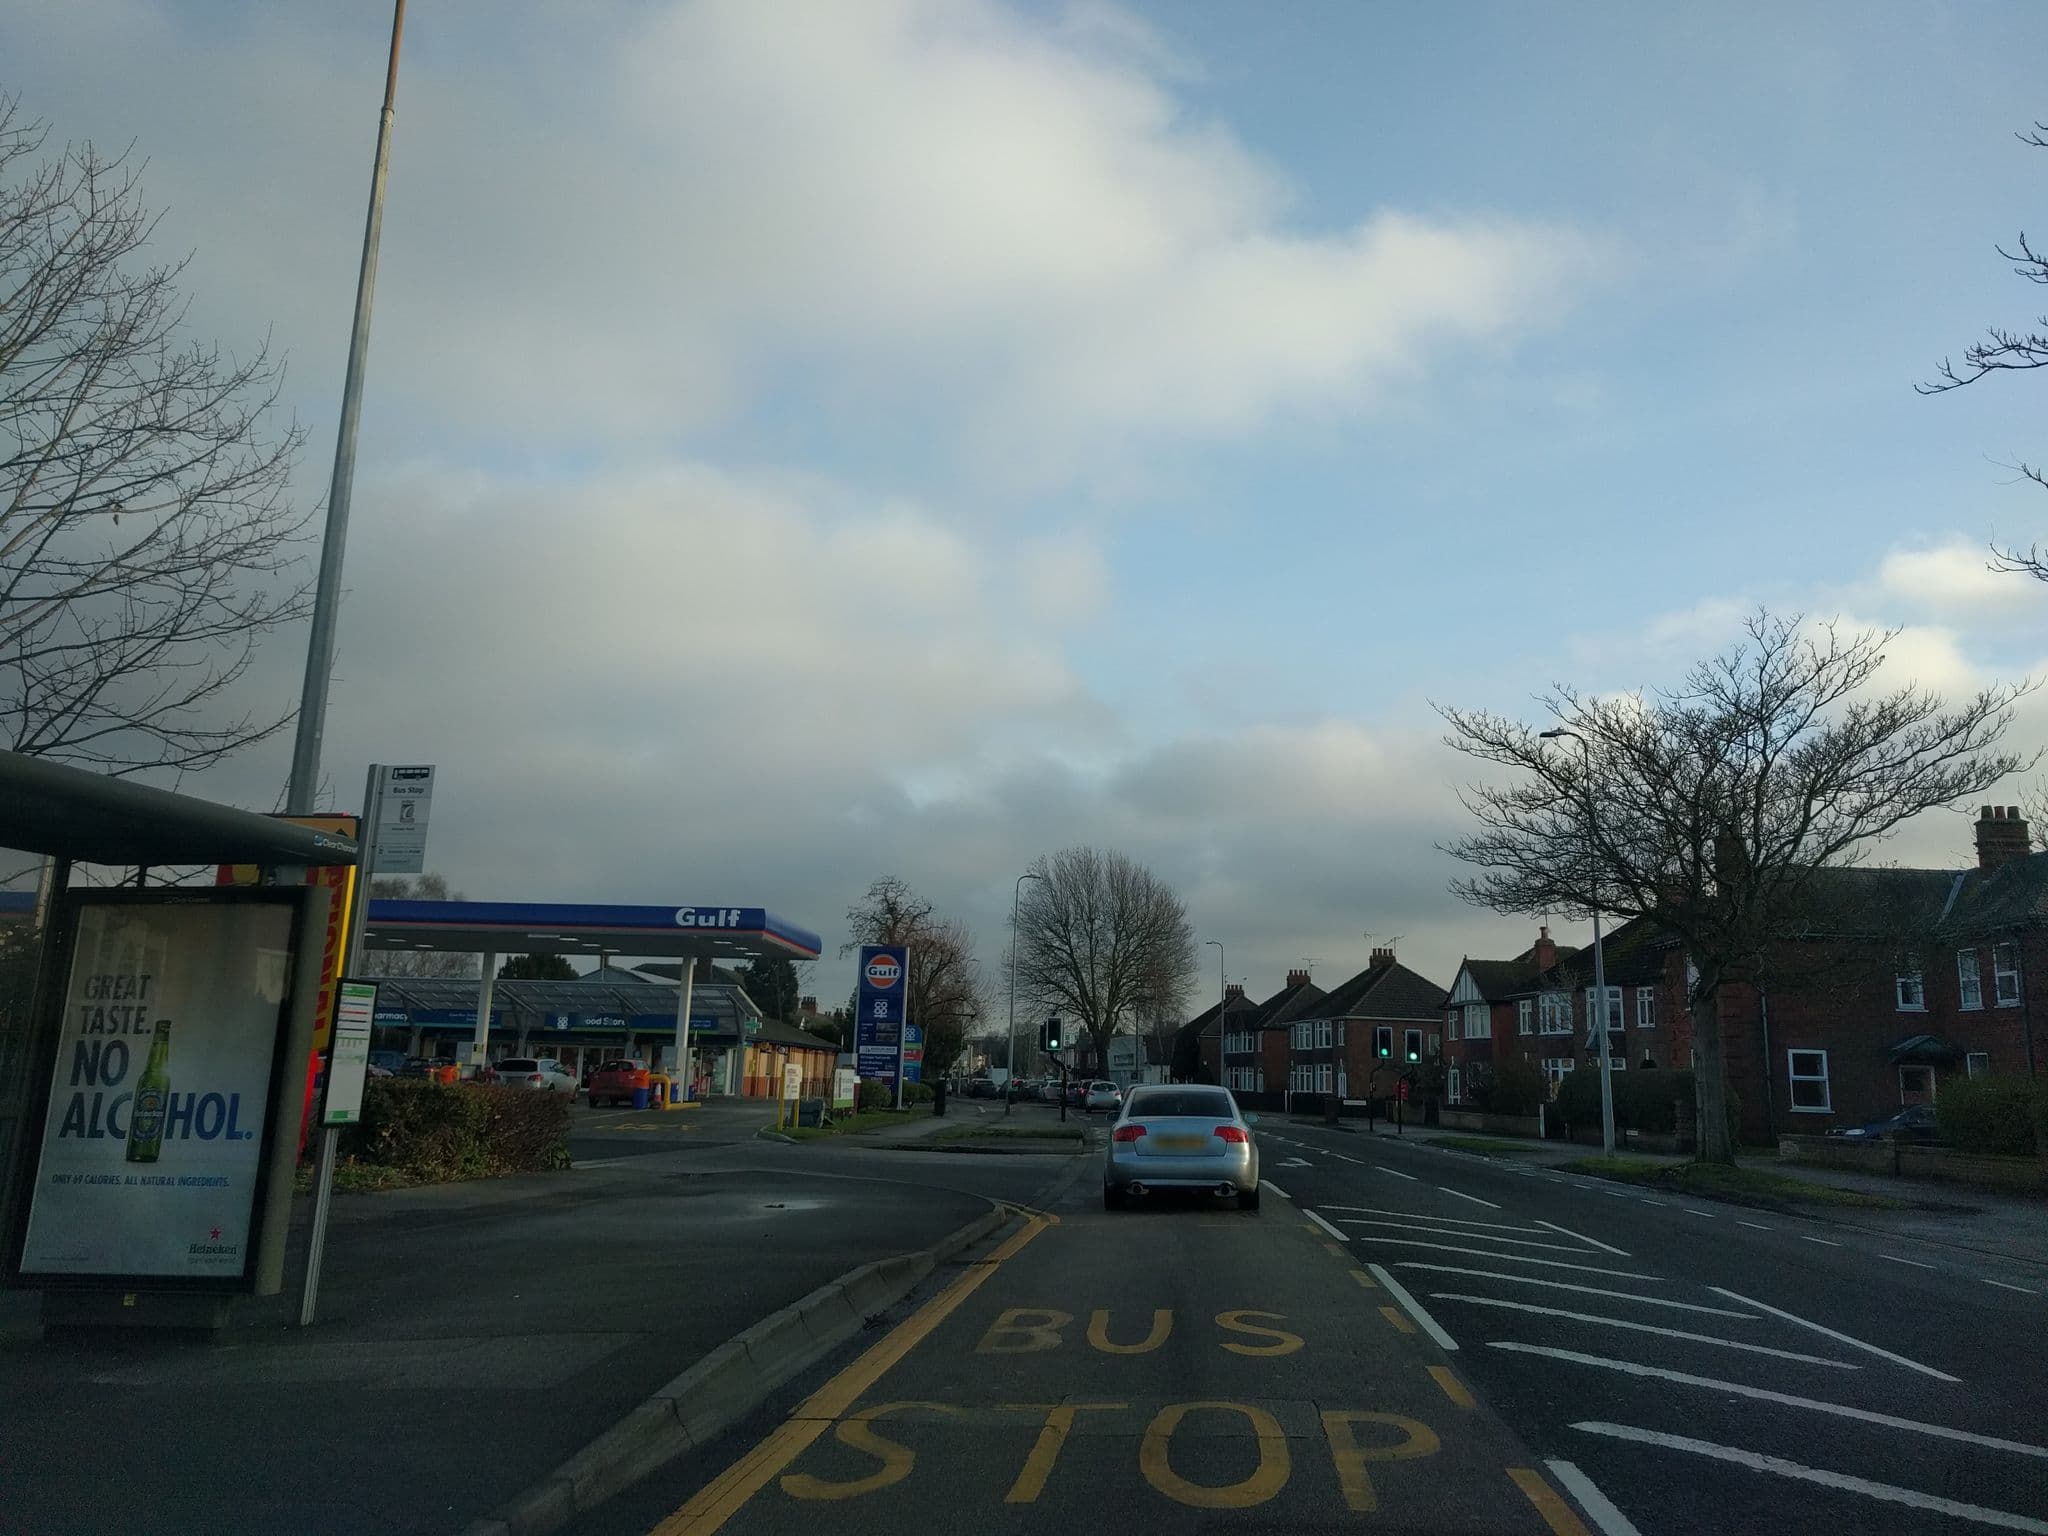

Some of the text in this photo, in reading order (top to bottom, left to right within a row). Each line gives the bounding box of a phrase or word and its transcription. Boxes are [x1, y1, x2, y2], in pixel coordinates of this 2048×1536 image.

[393, 786, 425, 795] Bus Stop
[675, 907, 740, 928] Gulf
[868, 966, 899, 977] Gulf
[83, 975, 152, 1001] GREAT
[80, 1005, 152, 1035] TASTE.
[375, 1012, 409, 1022] armacy
[69, 1039, 130, 1087] NO
[59, 1092, 253, 1140] ALCHOL.
[51, 1174, 71, 1185] ONLY
[124, 1175, 138, 1186] ALL
[140, 1175, 176, 1187] NATURAL
[189, 1243, 237, 1255] Heineken
[976, 1308, 1305, 1357] BUS
[780, 1399, 1442, 1512] STOP
